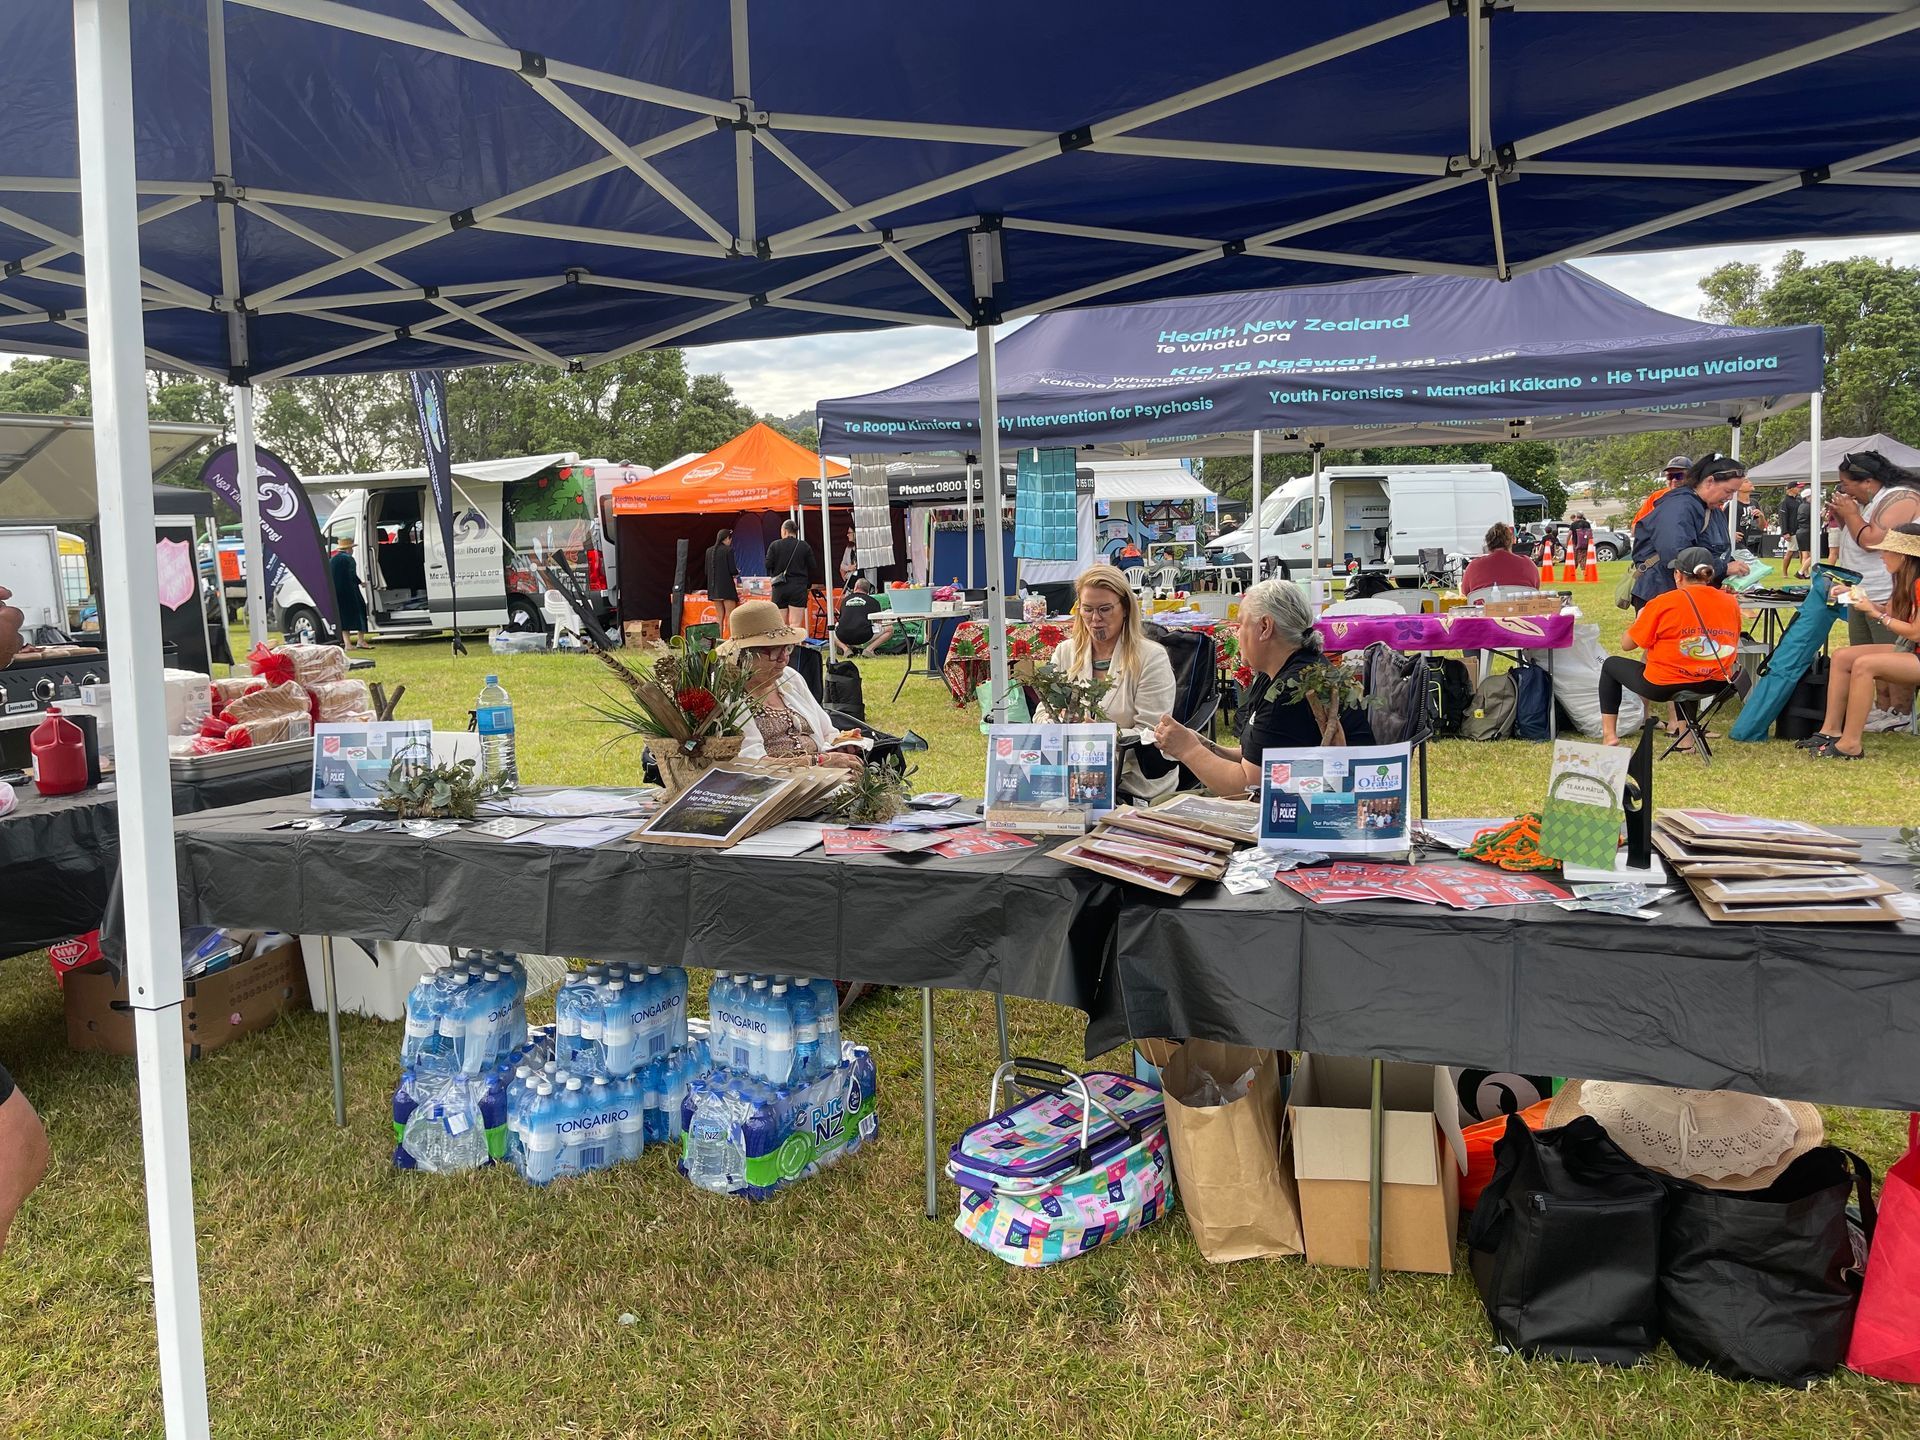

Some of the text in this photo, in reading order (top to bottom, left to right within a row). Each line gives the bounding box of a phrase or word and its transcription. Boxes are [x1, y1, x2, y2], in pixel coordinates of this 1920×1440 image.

[1158, 314, 1411, 343] Health New Zealand
[1156, 332, 1291, 354] Te Whatu Ora
[1170, 365, 1214, 376] Kia
[1257, 355, 1378, 370] Ngāwari
[1269, 355, 1778, 404] Youth Forensics Manaaki Kākano He Tupua Waiora
[844, 421, 861, 433] Te
[863, 420, 906, 435] Roopu
[907, 418, 961, 431] Kimiora
[1017, 409, 1107, 428] Intervention
[1110, 406, 1132, 419] for
[1135, 397, 1214, 419] Psychosis
[899, 484, 935, 495] Phone:
[936, 481, 962, 493] 0800
[8, 702, 36, 713] jumbuck
[329, 772, 345, 782] POLICE
[1279, 808, 1297, 819] POLICE
[631, 995, 681, 1026] TONGARIRO
[717, 1010, 768, 1034] TONGARIRO
[556, 1109, 630, 1135] TONGARIRO
[815, 1109, 846, 1146] NZ
